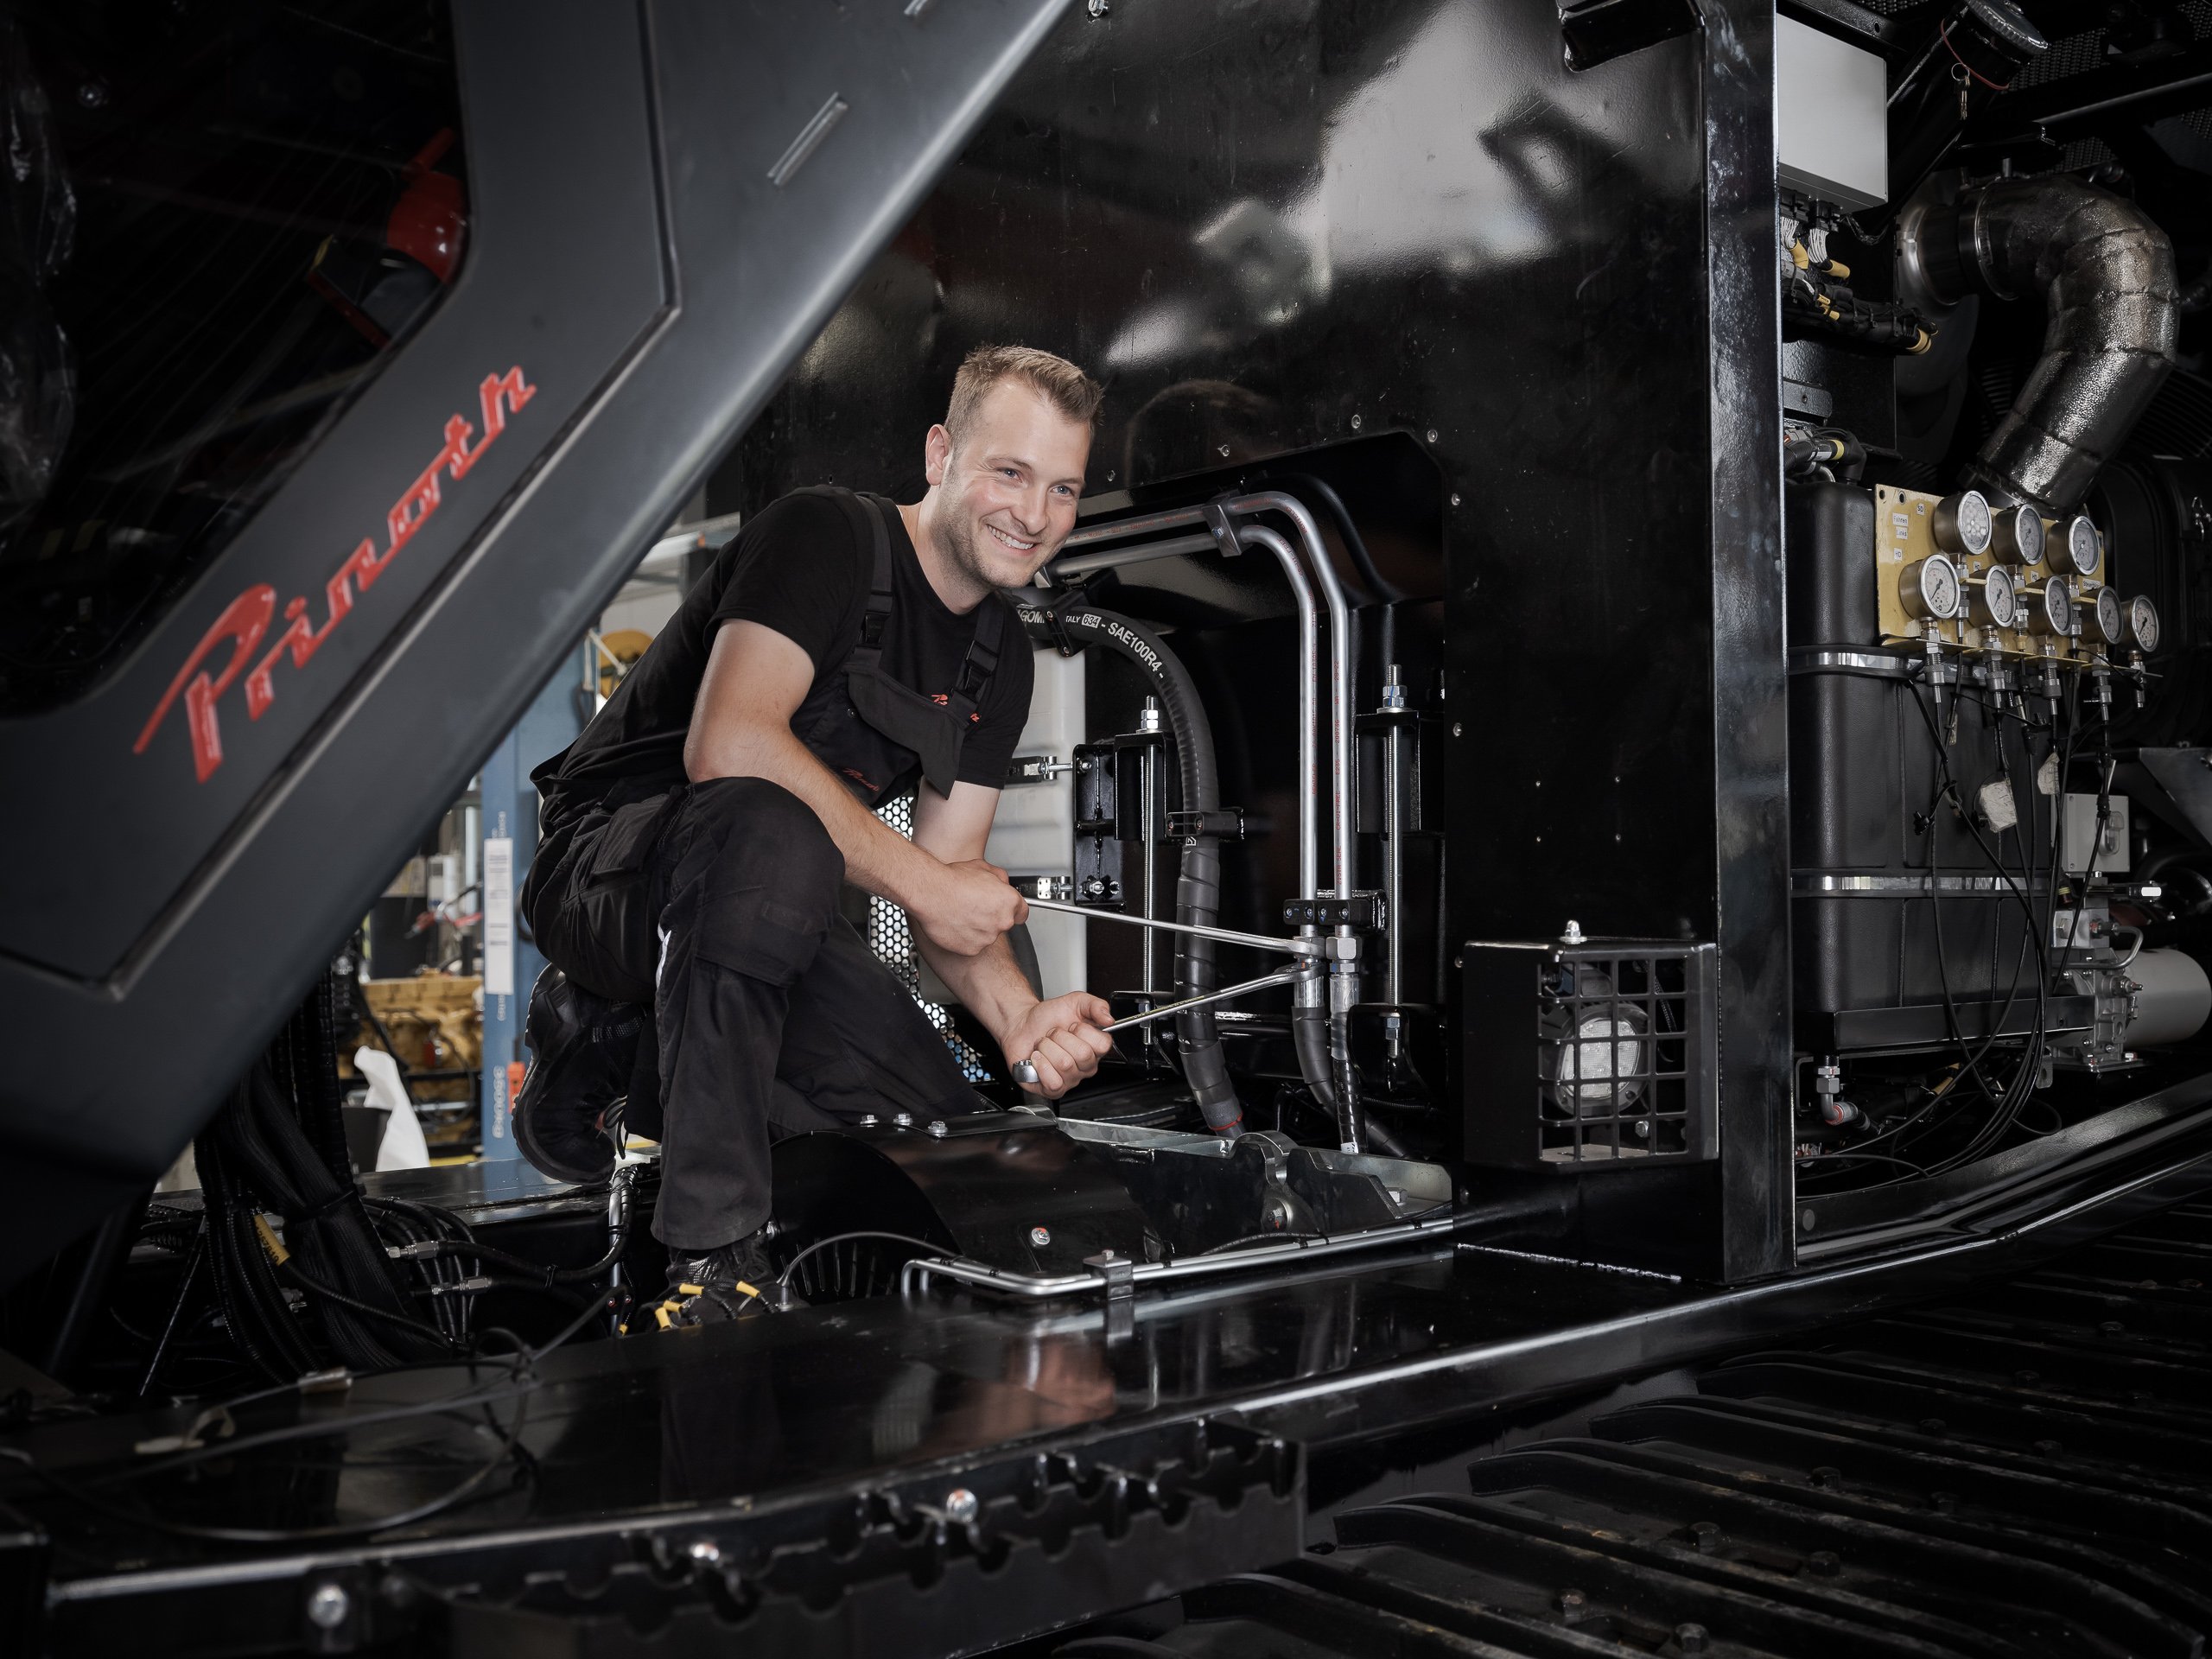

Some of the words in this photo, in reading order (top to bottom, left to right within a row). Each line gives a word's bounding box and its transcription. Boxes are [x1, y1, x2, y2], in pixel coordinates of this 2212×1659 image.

[1893, 515, 1908, 524] Fahren
[132, 365, 537, 785] Prinoth
[1016, 608, 1045, 624] GOM
[1083, 614, 1100, 626] 634
[1108, 622, 1163, 671] SAE100R4
